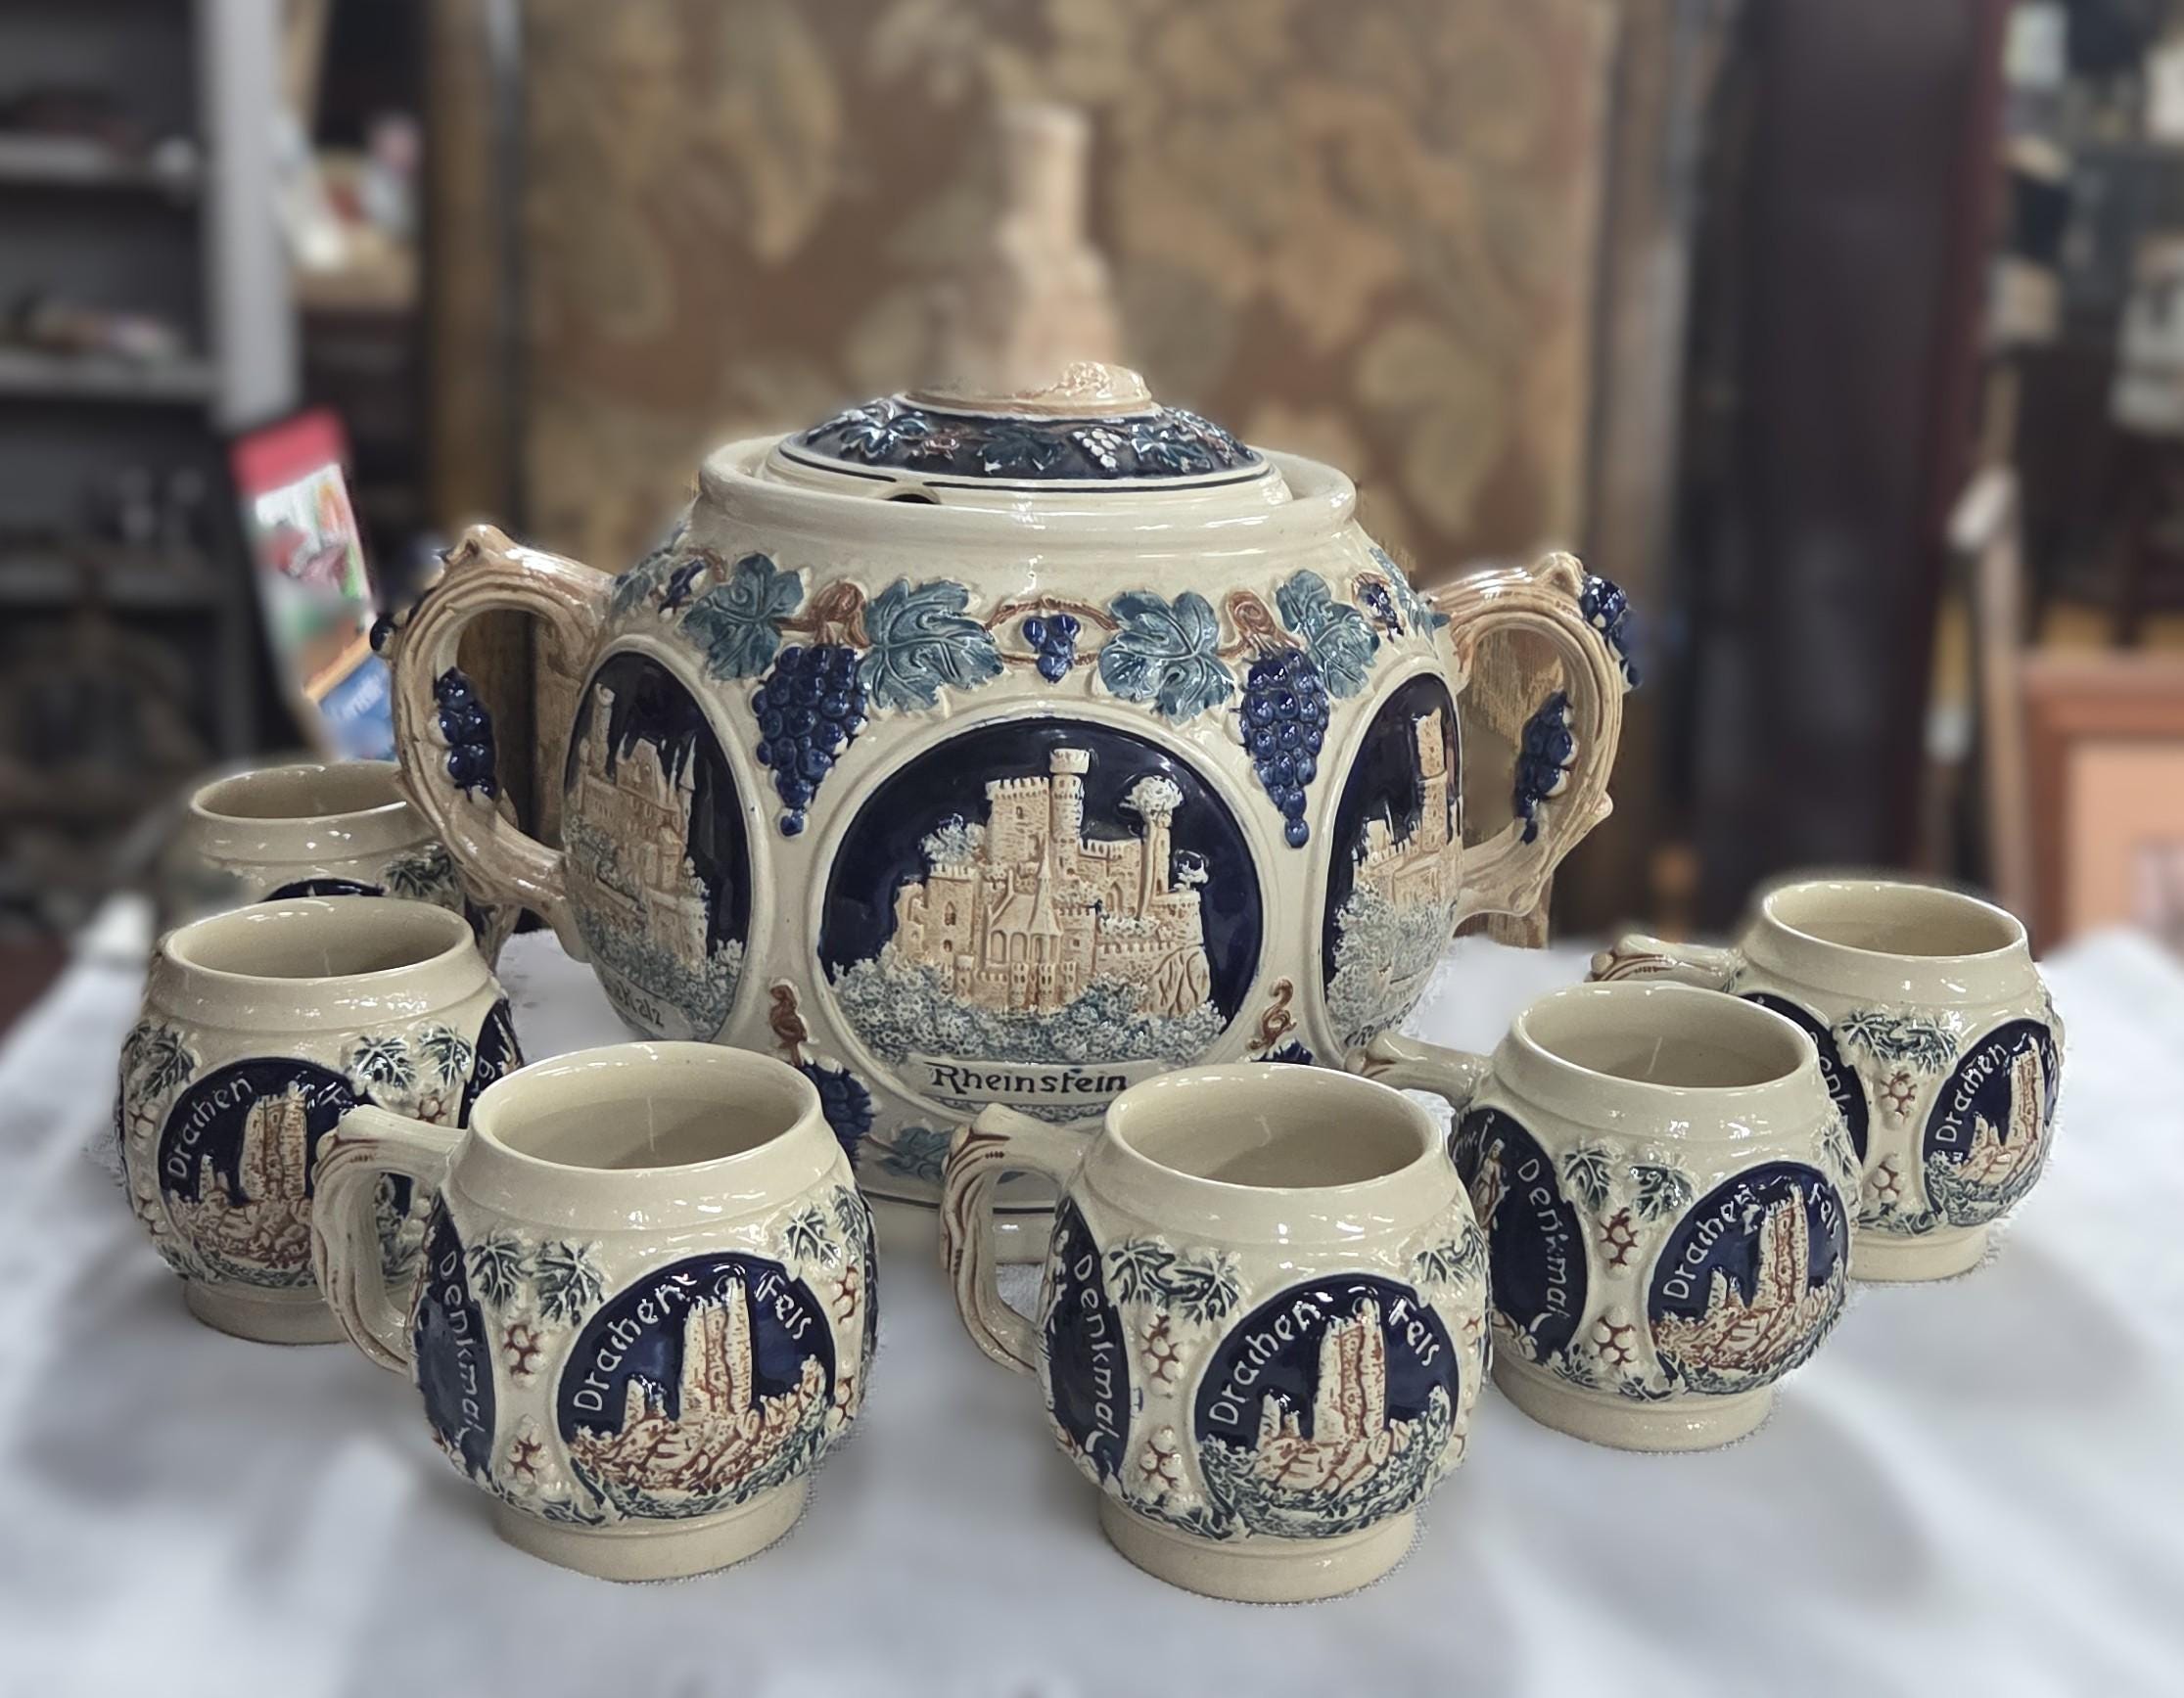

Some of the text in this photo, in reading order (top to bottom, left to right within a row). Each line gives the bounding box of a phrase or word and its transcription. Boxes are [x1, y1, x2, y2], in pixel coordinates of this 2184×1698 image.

[166, 1077, 254, 1178] Drachen
[924, 1061, 1126, 1095] Rheinstein
[1935, 1043, 2008, 1143] Drachen
[440, 1251, 486, 1434] Denkmal
[573, 1271, 813, 1411] Drachen Fels
[1074, 1253, 1121, 1441] Denkmal
[1209, 1300, 1322, 1425] Drachen
